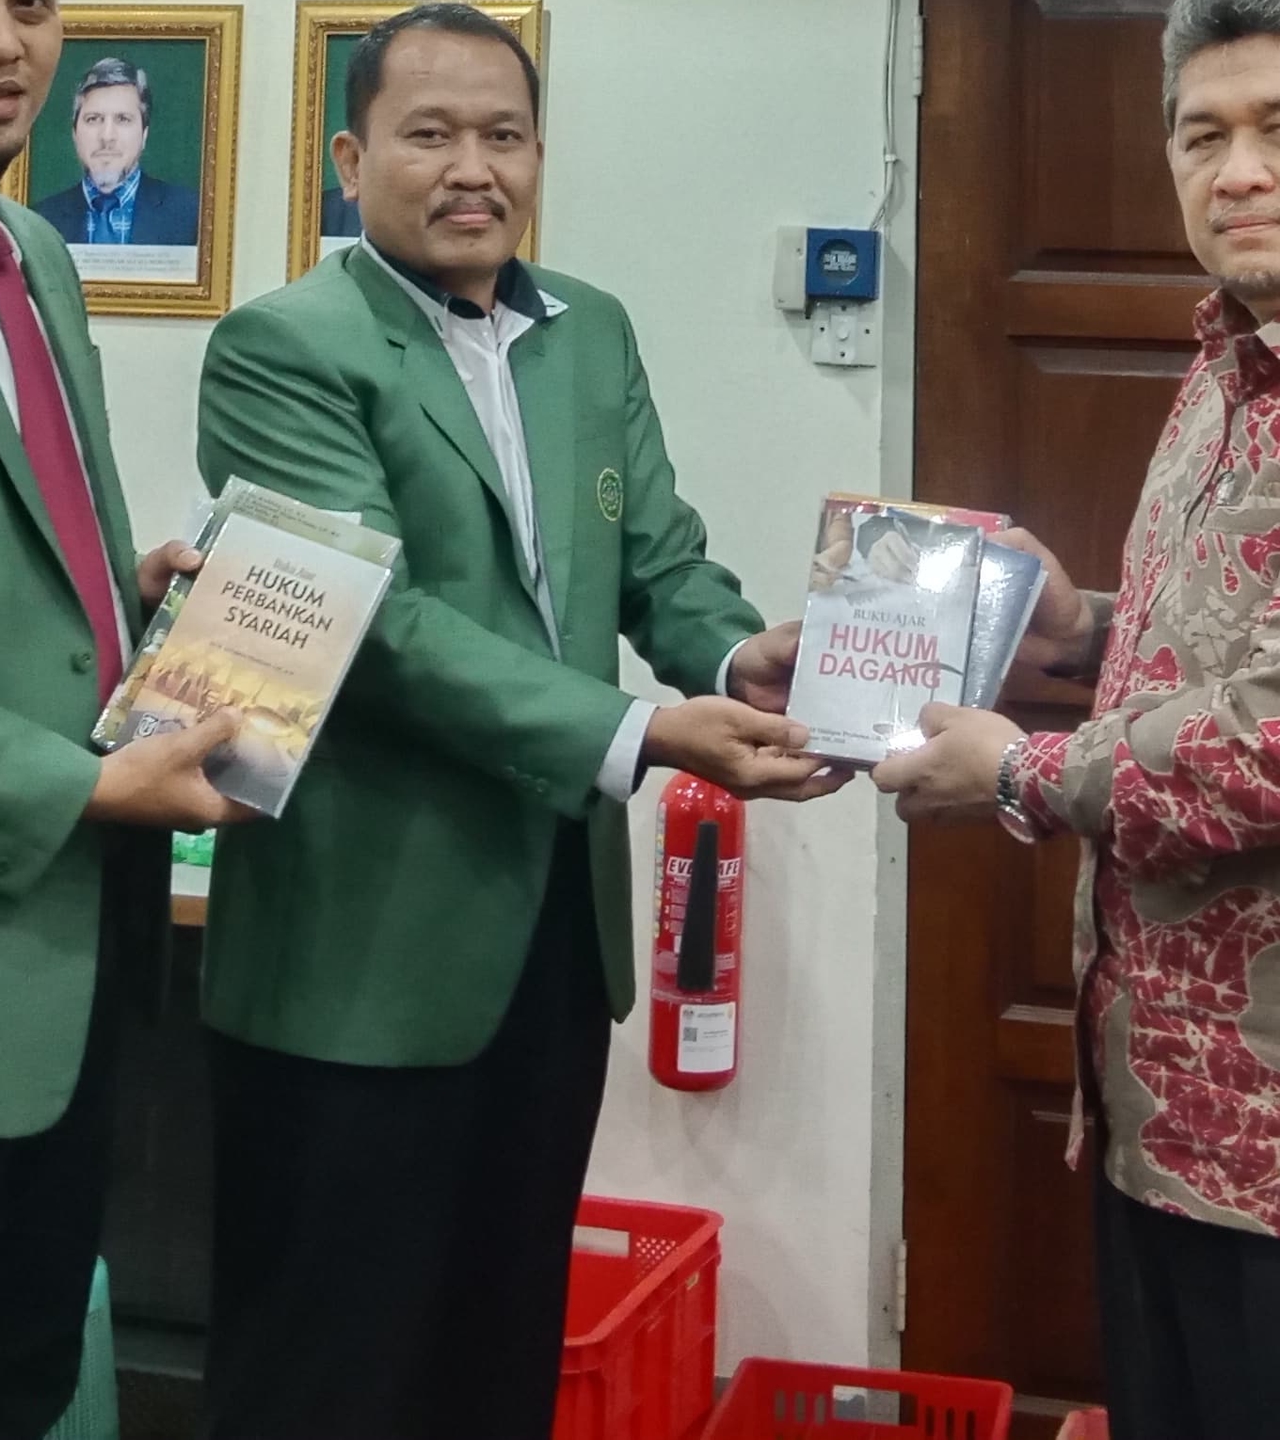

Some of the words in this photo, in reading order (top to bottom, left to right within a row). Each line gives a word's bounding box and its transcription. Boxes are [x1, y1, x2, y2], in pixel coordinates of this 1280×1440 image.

[246, 565, 326, 607] HUKUM
[220, 581, 334, 633] PERBANKAN
[853, 609, 891, 622] BUKU
[894, 613, 926, 627] AJAR
[224, 606, 309, 649] SYARIAH
[829, 622, 938, 661] HUKUM
[818, 653, 941, 689] DAGANG
